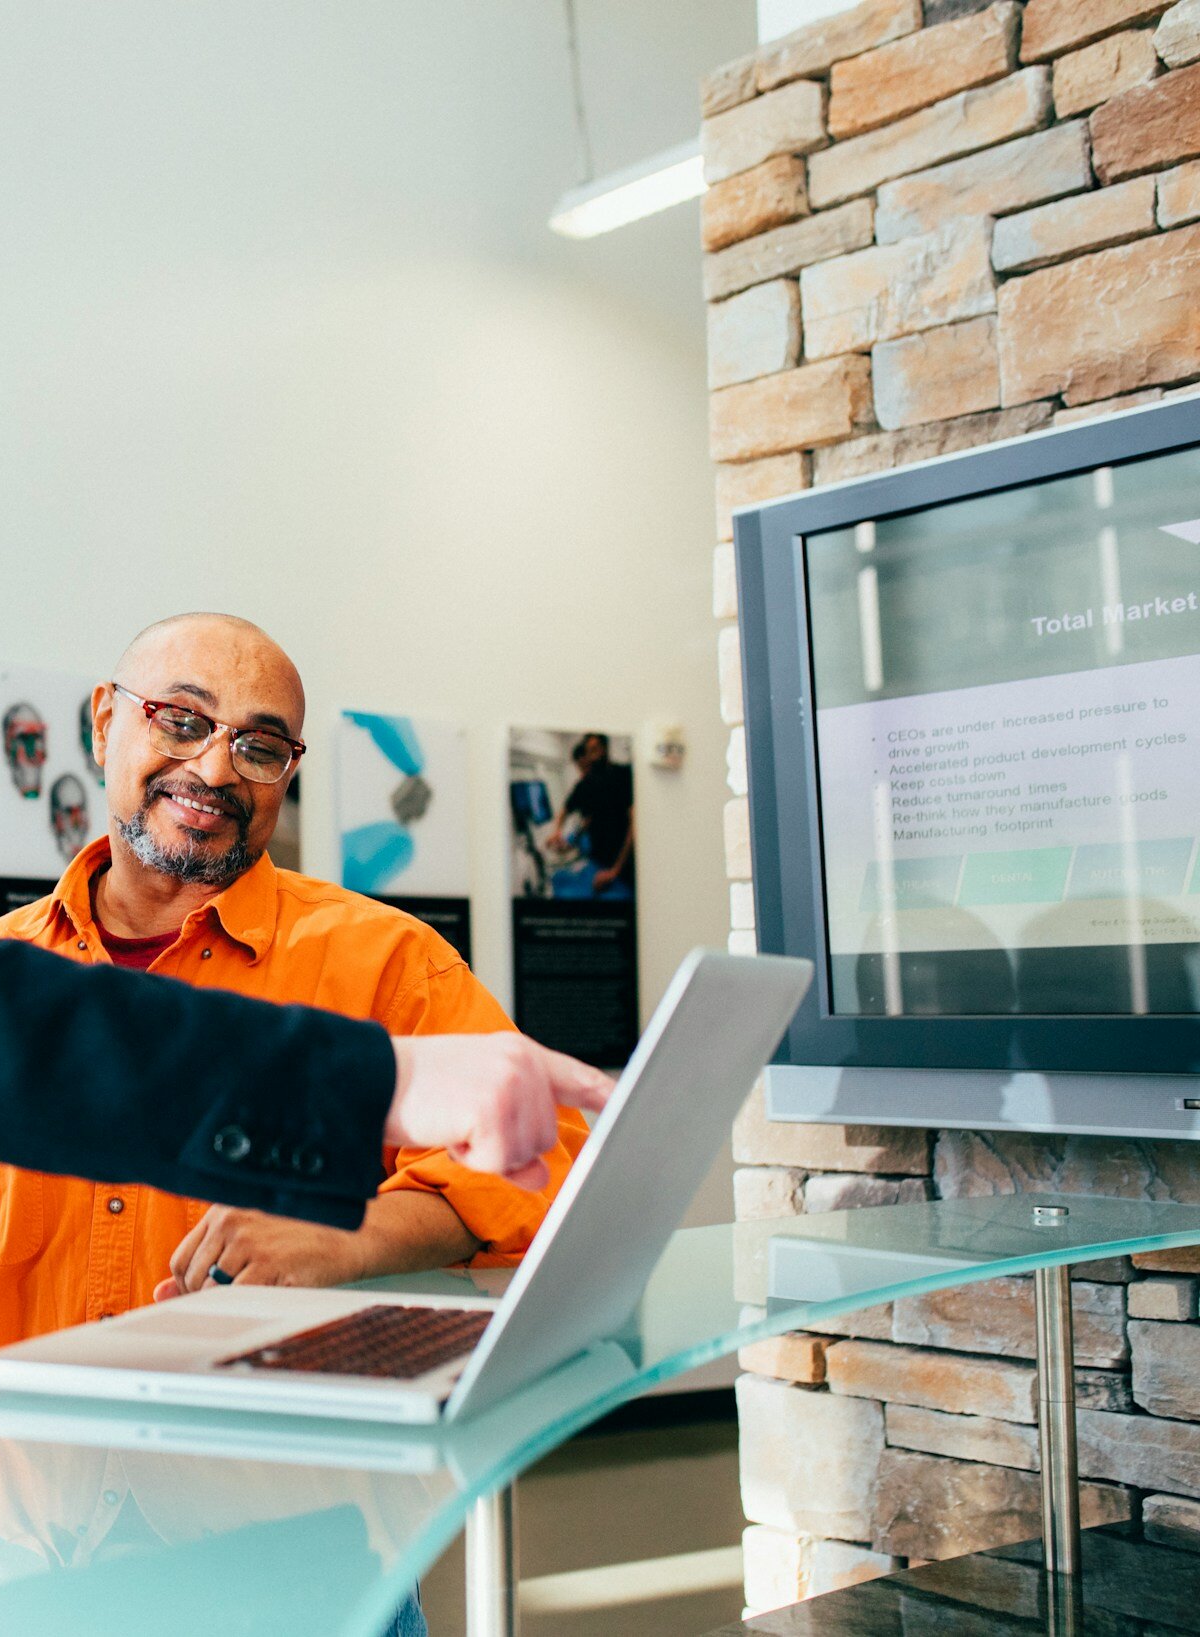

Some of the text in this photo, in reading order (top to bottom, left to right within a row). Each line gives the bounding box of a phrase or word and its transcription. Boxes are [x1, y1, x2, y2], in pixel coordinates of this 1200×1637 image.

[1031, 591, 1198, 636] Total Market
[887, 697, 1169, 743] CEOs are under increased pressure to
[888, 739, 970, 759] drive growth
[889, 732, 1187, 775] Accelerated product development cycles
[890, 770, 1006, 793] Keep costs down
[892, 782, 1067, 808] Reduce turnaround times
[892, 788, 1168, 824] Re-think how they manufacture goods
[893, 817, 1054, 841] Manufacturing footprint
